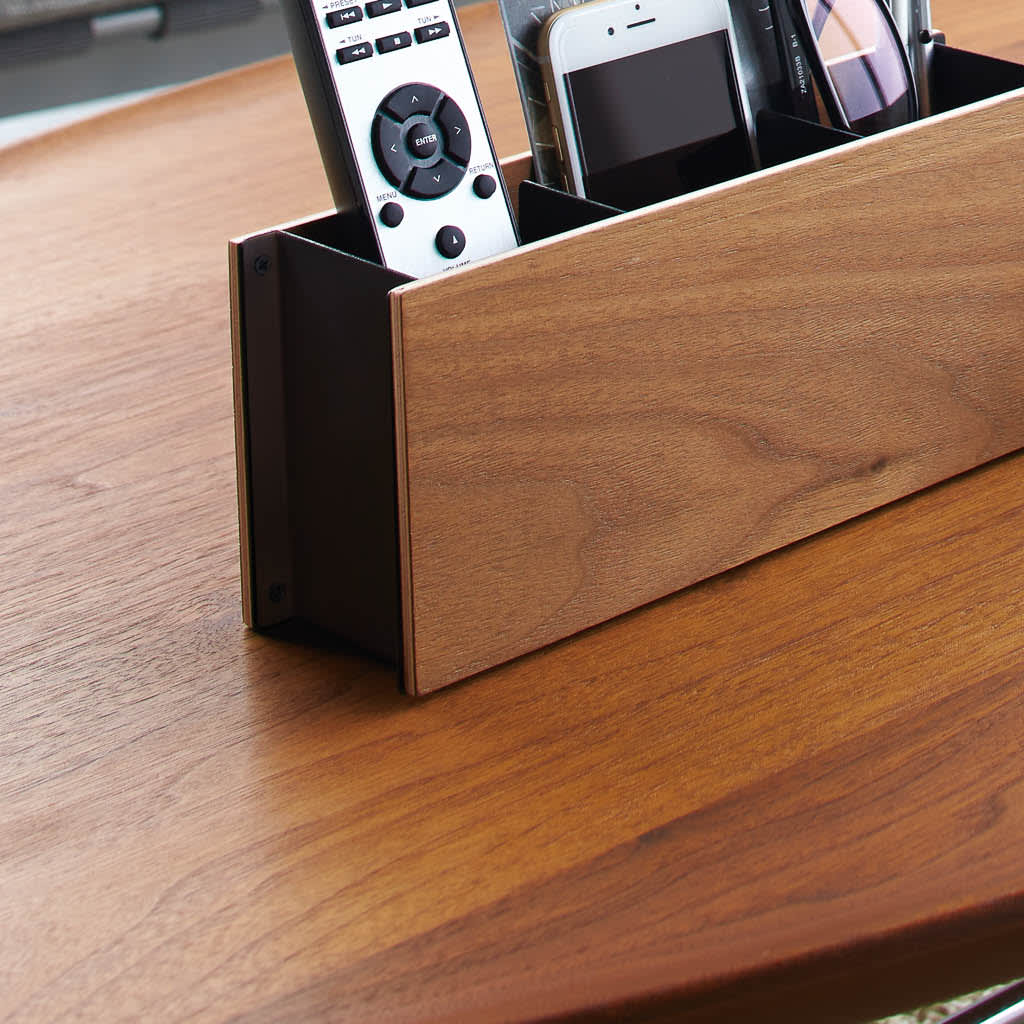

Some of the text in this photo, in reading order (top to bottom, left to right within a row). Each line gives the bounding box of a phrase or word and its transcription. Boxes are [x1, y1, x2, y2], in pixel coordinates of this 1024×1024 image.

[418, 16, 432, 24] TUN
[347, 34, 362, 43] TUN
[416, 134, 437, 146] ENTER
[469, 162, 495, 174] RETURN
[376, 191, 397, 203] MENU
